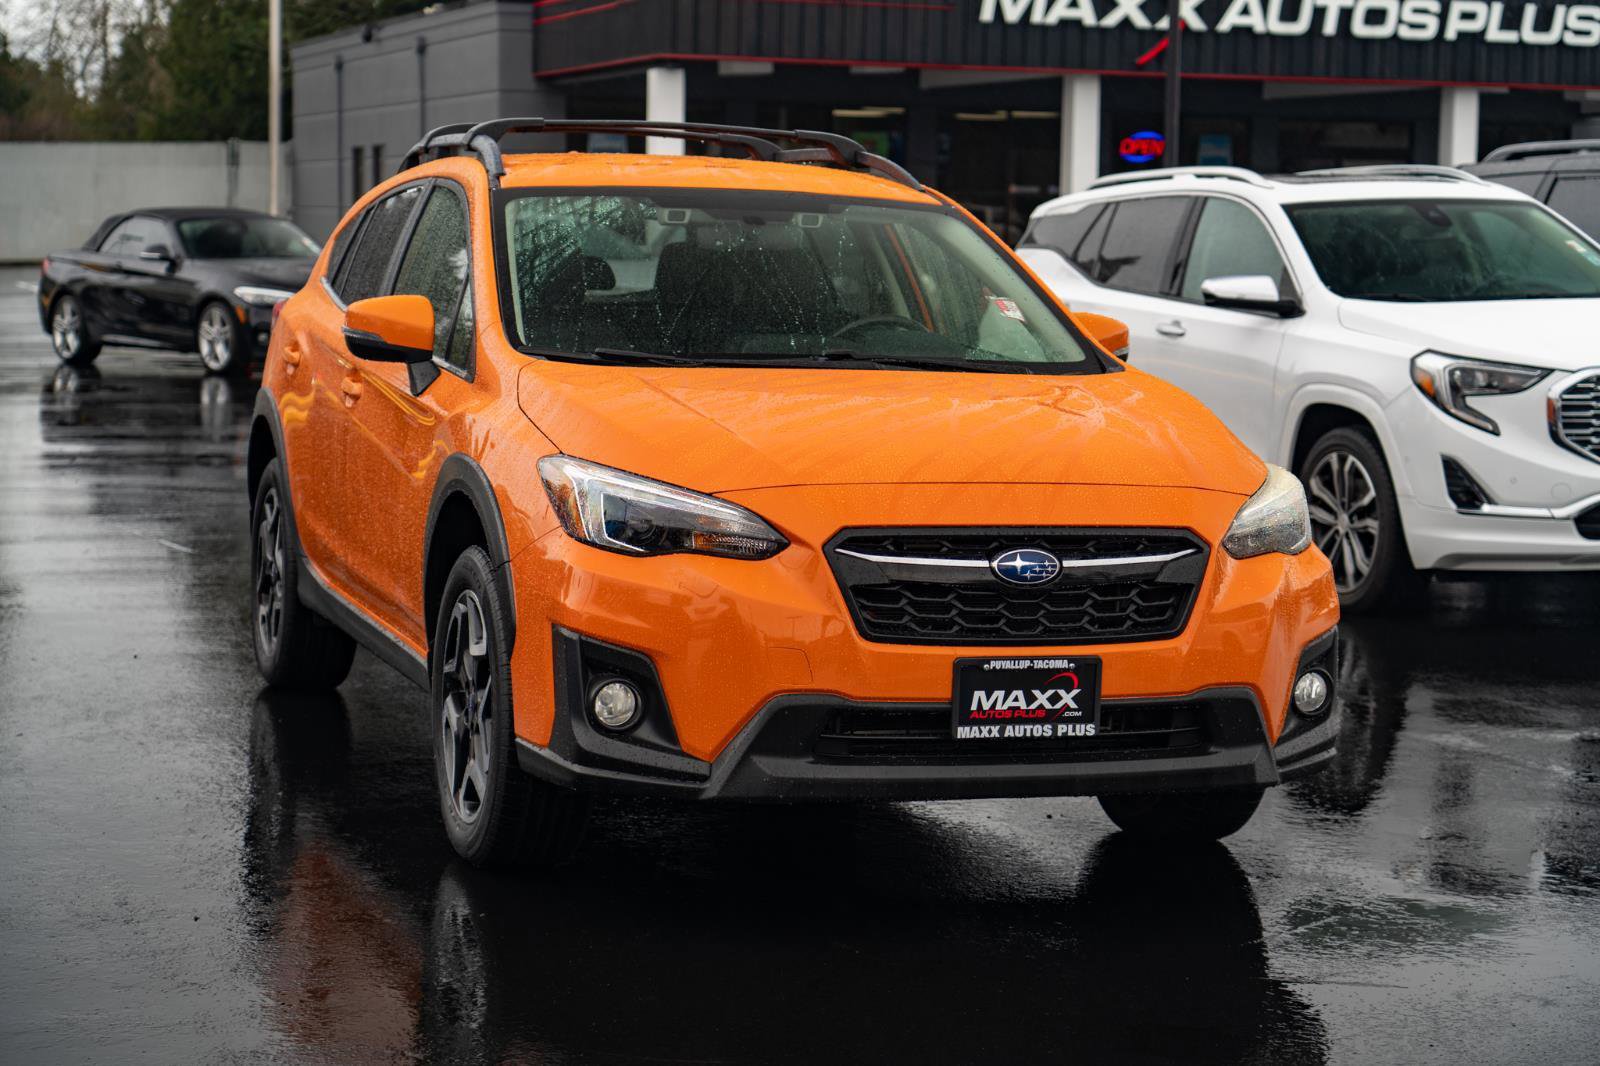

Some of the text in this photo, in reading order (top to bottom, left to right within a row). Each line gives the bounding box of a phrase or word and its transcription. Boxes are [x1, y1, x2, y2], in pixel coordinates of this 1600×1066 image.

[1215, 0, 1441, 41] AUTOS
[1444, 0, 1600, 47] PLUS
[1120, 137, 1165, 157] OPEN
[970, 689, 1081, 711] MAXX
[970, 709, 1012, 719] AUTOS
[1014, 709, 1046, 718] PLUS
[957, 724, 1096, 738] MAXX AUTOS PLUS
